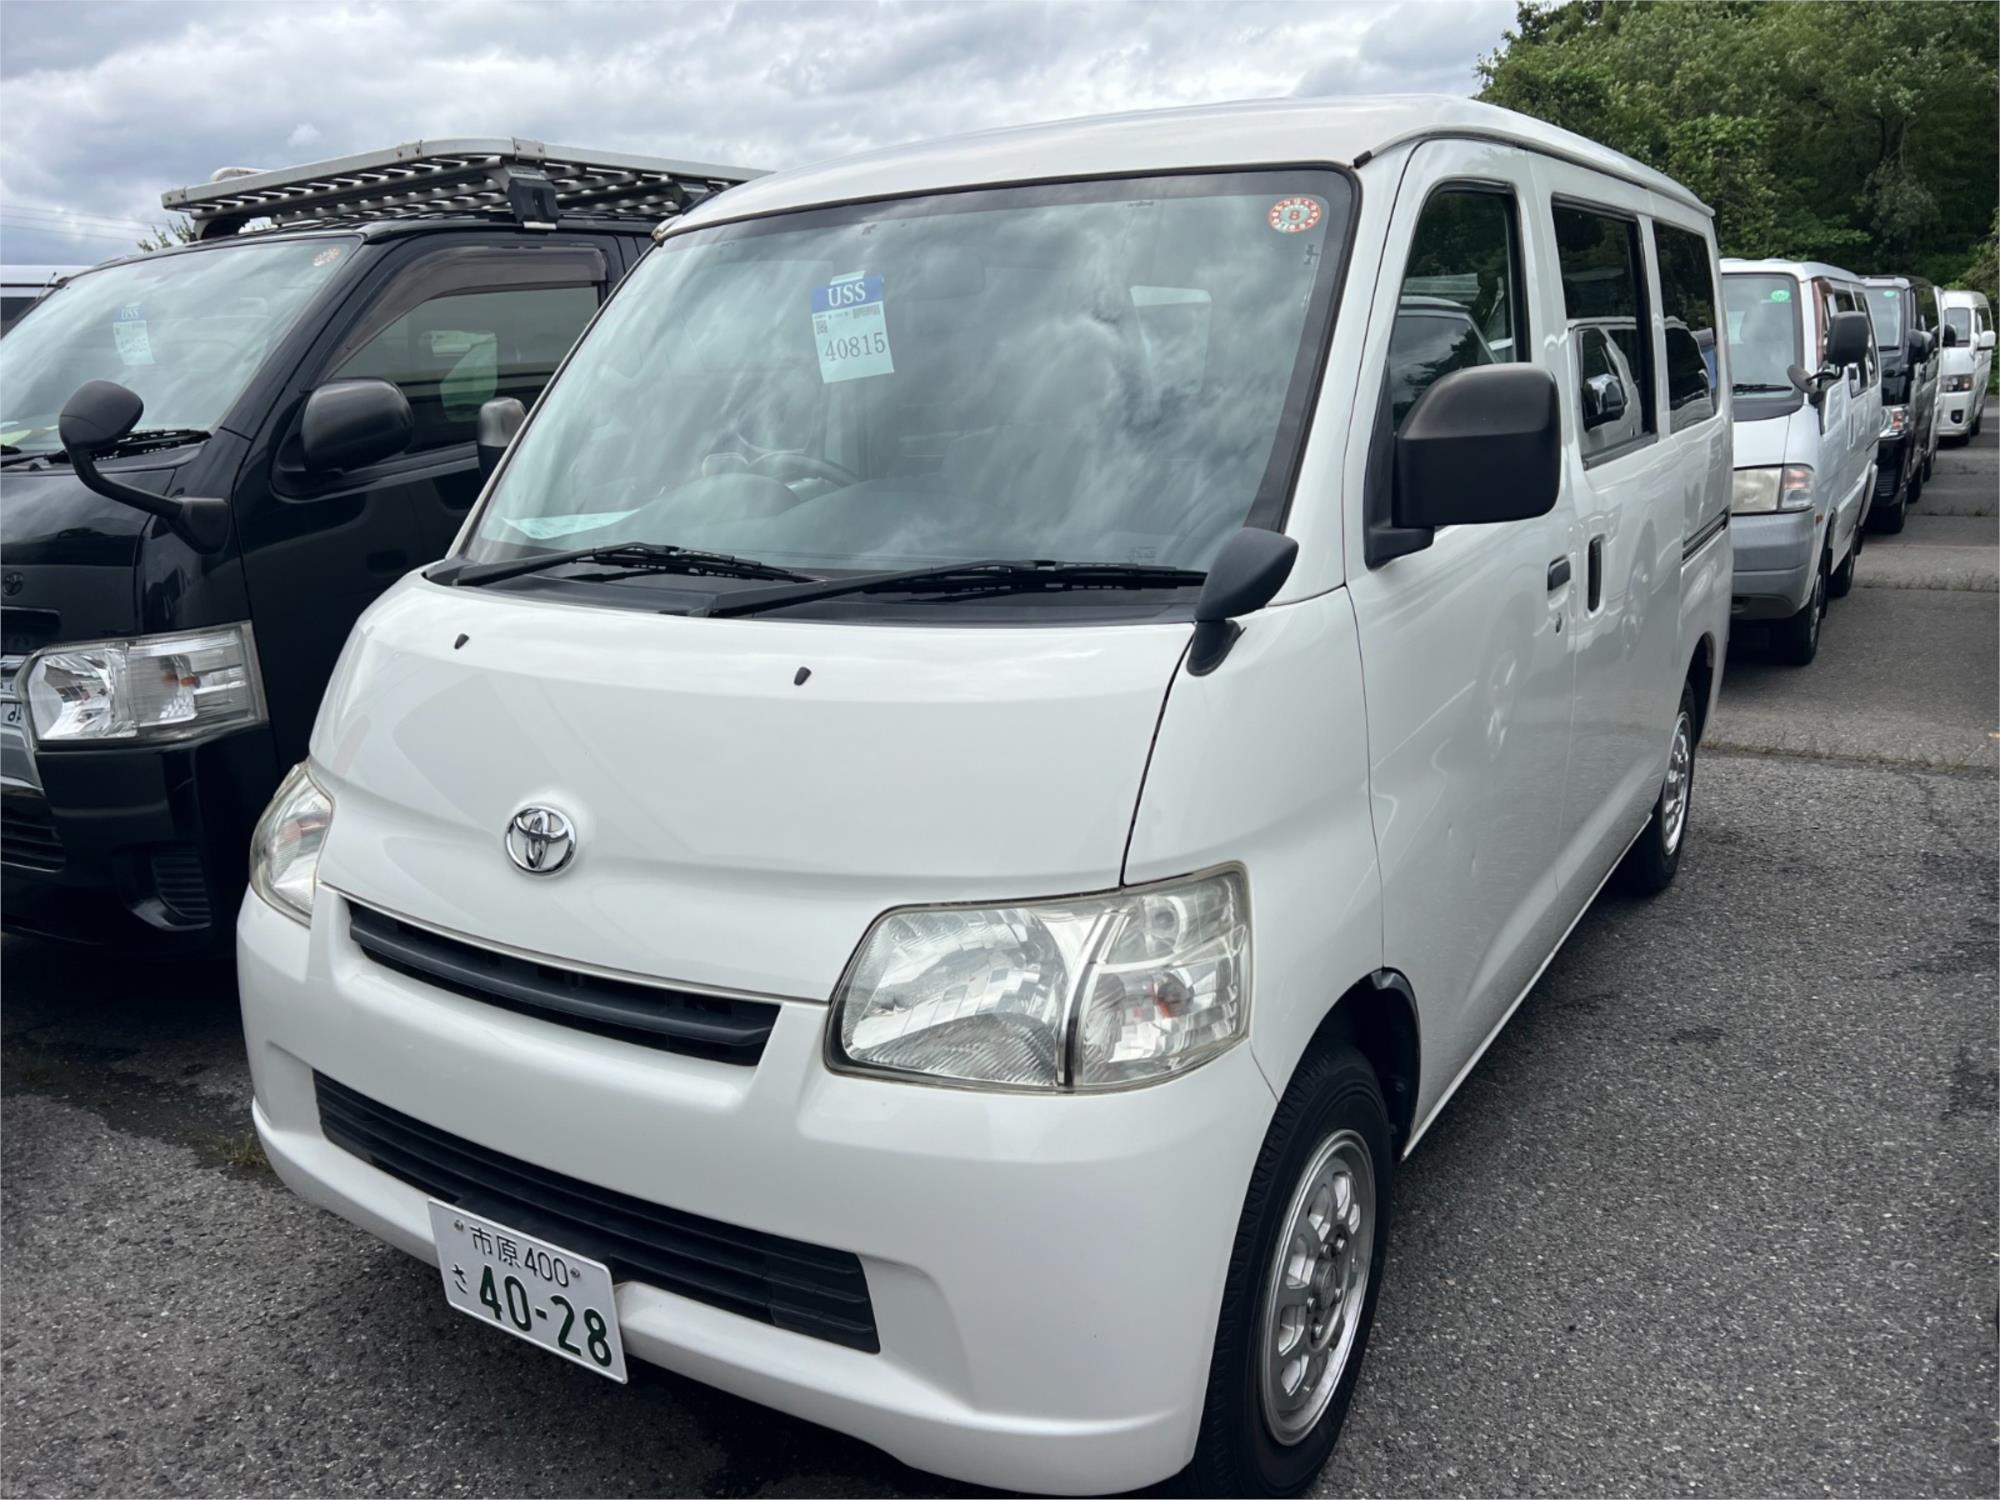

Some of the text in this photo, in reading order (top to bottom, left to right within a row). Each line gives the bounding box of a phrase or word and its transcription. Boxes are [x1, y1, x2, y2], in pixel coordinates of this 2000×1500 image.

[828, 281, 866, 307] USS
[825, 331, 886, 361] 40815
[452, 1264, 612, 1367] さ 40-28
